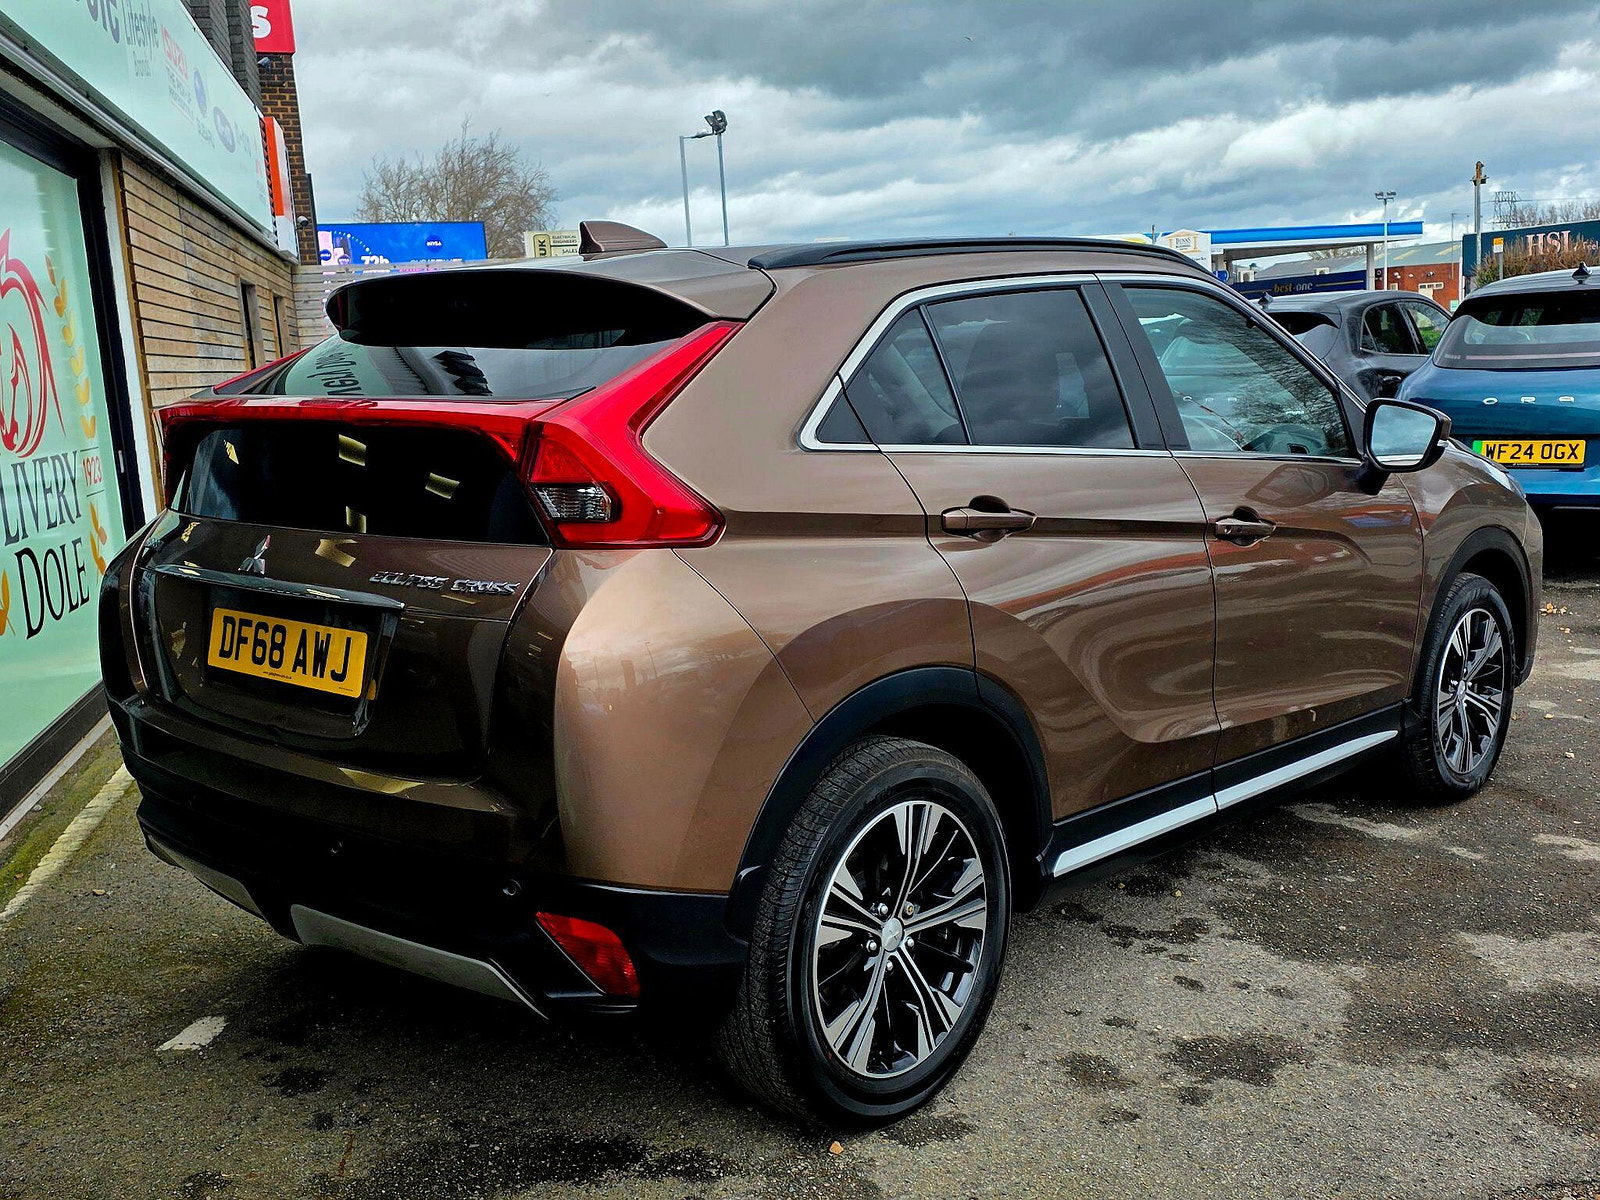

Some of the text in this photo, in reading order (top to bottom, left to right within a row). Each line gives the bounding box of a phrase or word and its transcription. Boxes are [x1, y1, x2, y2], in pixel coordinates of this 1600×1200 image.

[1485, 443, 1580, 460] WF24 OGX
[369, 570, 521, 596] ECLIPSE CROSS
[218, 615, 353, 683] DF68 AWJ
